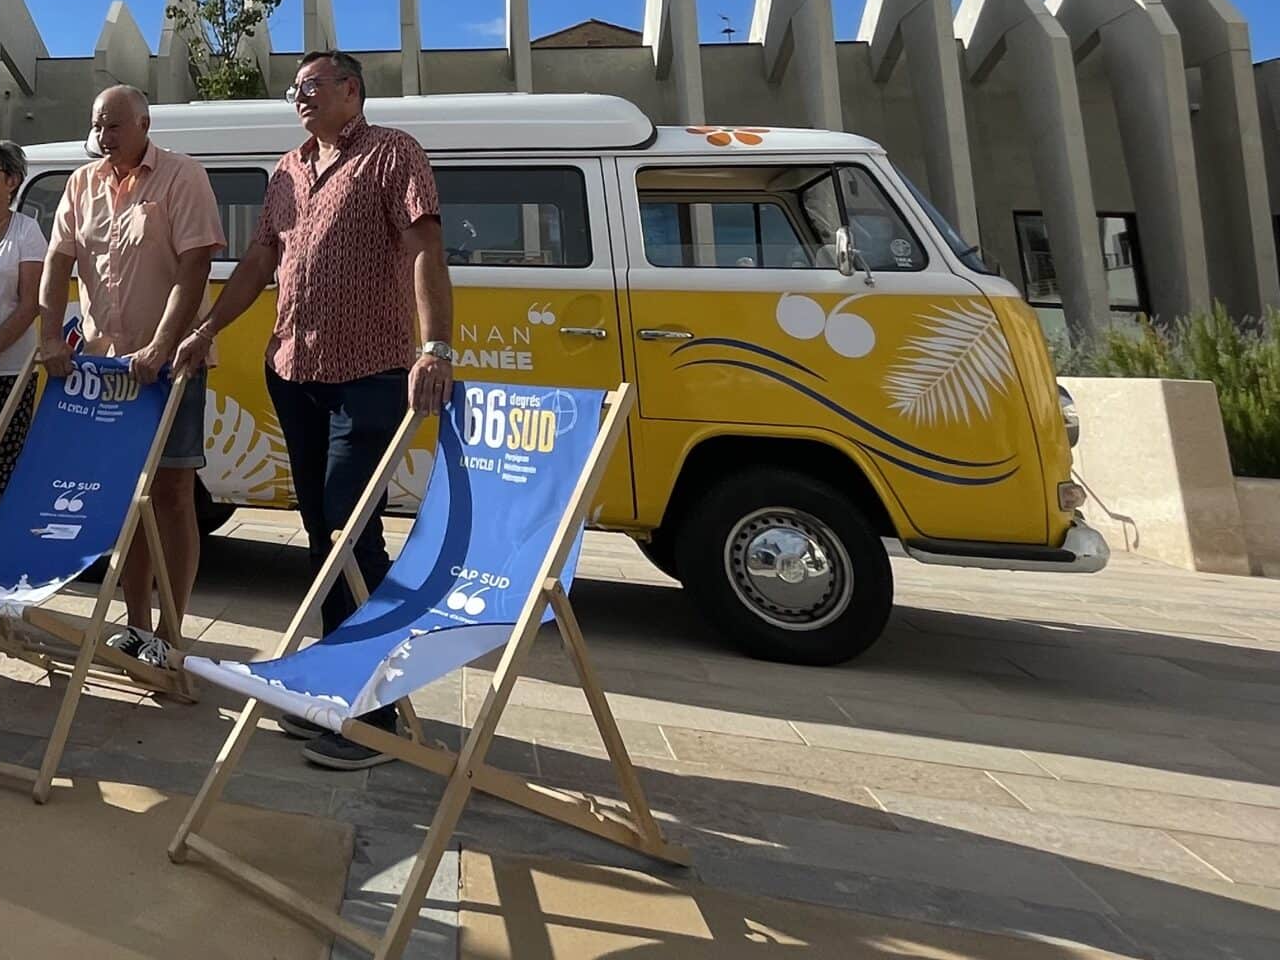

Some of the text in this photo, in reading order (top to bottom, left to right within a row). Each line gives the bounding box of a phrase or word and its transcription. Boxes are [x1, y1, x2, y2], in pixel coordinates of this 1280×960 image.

[64, 360, 101, 400] 66
[58, 401, 66, 410] LA
[67, 403, 89, 416] CYCLO
[464, 387, 541, 449] 66 degrés
[506, 408, 556, 453] SUD
[470, 456, 494, 472] CYCLO
[52, 480, 100, 491] CAP SUD
[450, 566, 510, 589] CAP SUD
